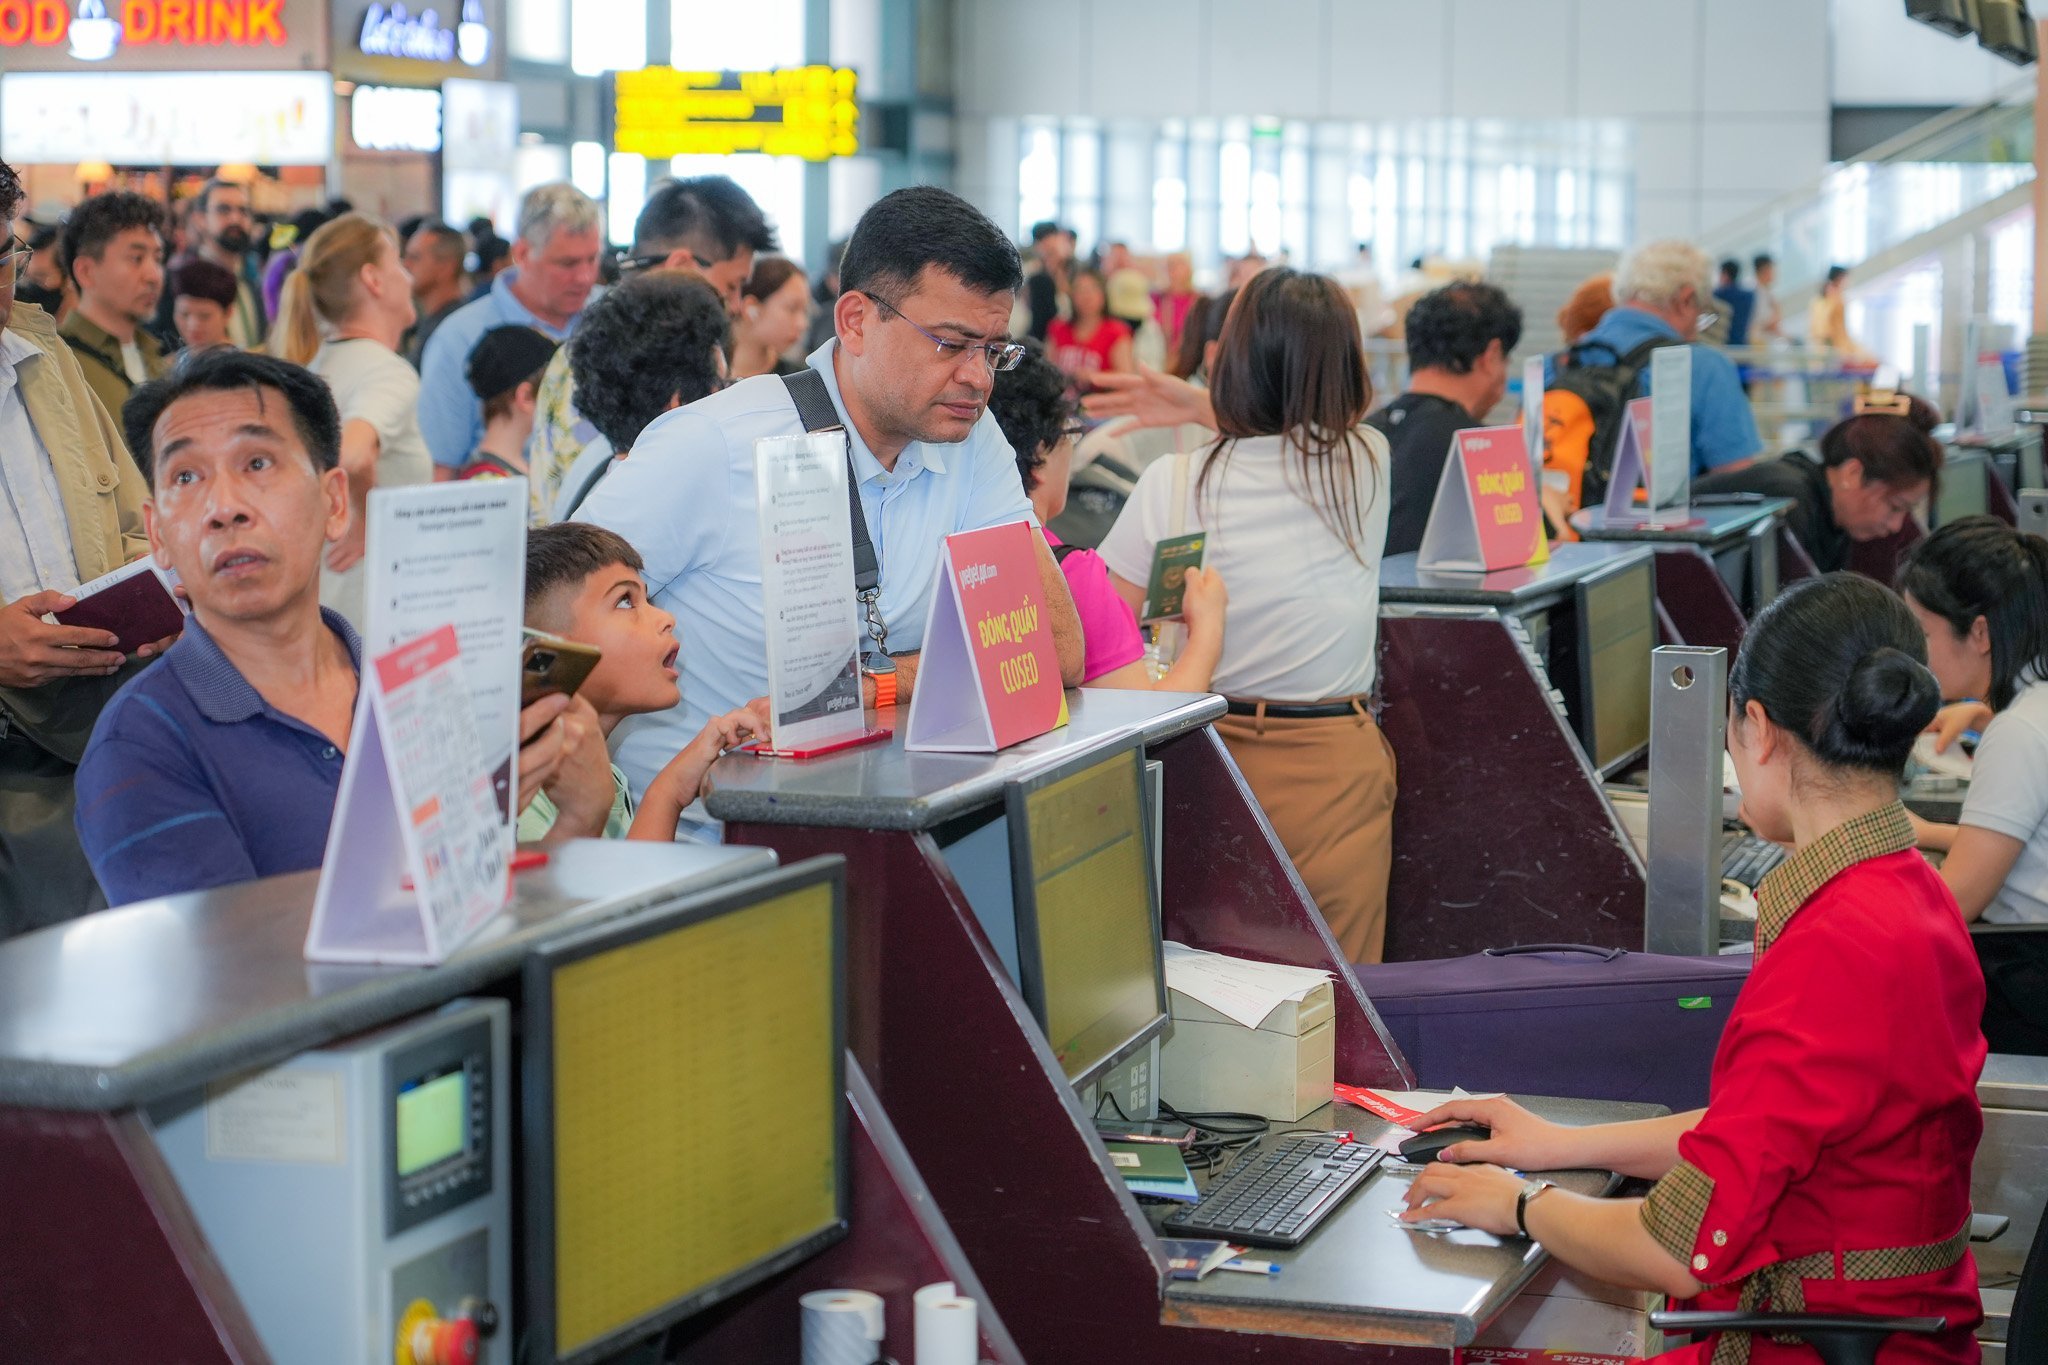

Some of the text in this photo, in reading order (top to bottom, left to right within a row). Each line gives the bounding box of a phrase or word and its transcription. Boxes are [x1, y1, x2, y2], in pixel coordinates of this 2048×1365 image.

[122, 0, 287, 47] DRINK
[977, 610, 1013, 649] ĐÓNG
[999, 651, 1040, 695] CLOSED
